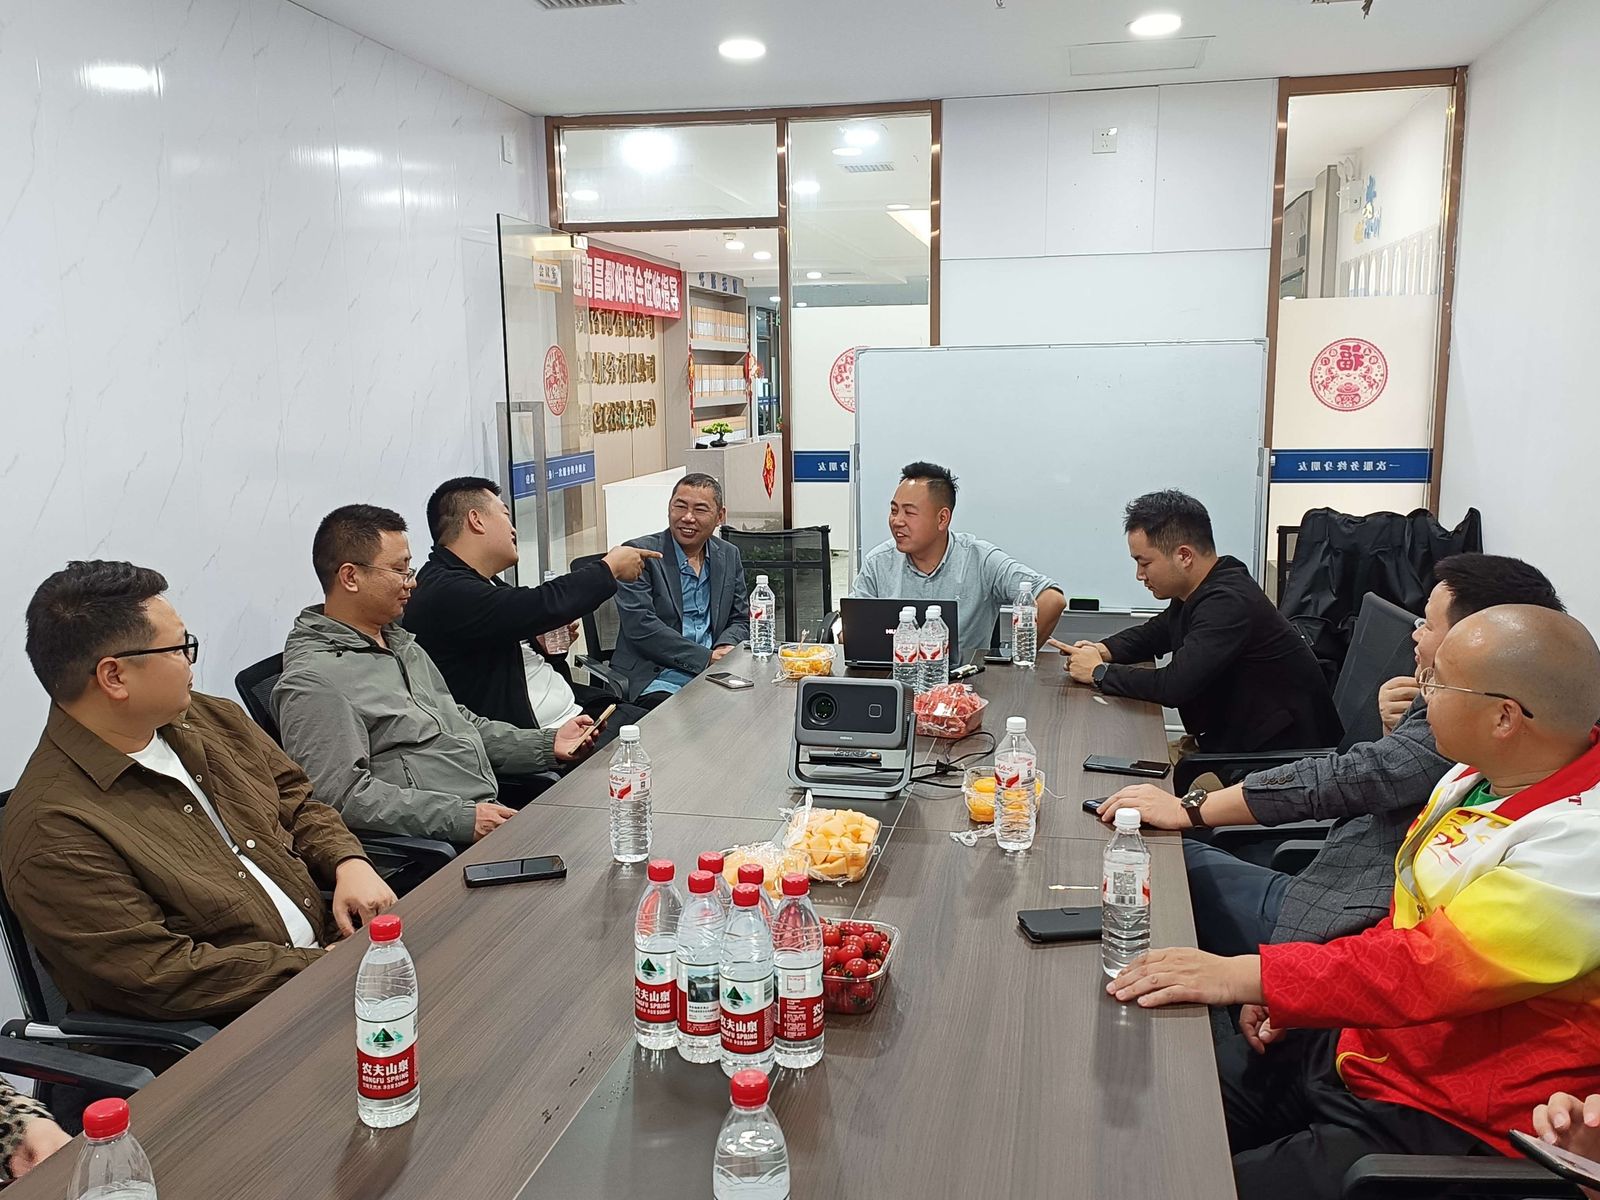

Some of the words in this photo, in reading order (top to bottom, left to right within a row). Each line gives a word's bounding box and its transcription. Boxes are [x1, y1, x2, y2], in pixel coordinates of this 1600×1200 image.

[362, 1059, 409, 1076] 农夫山泉
[362, 1074, 385, 1084] NONGFU
[386, 1072, 409, 1082] SPRING
